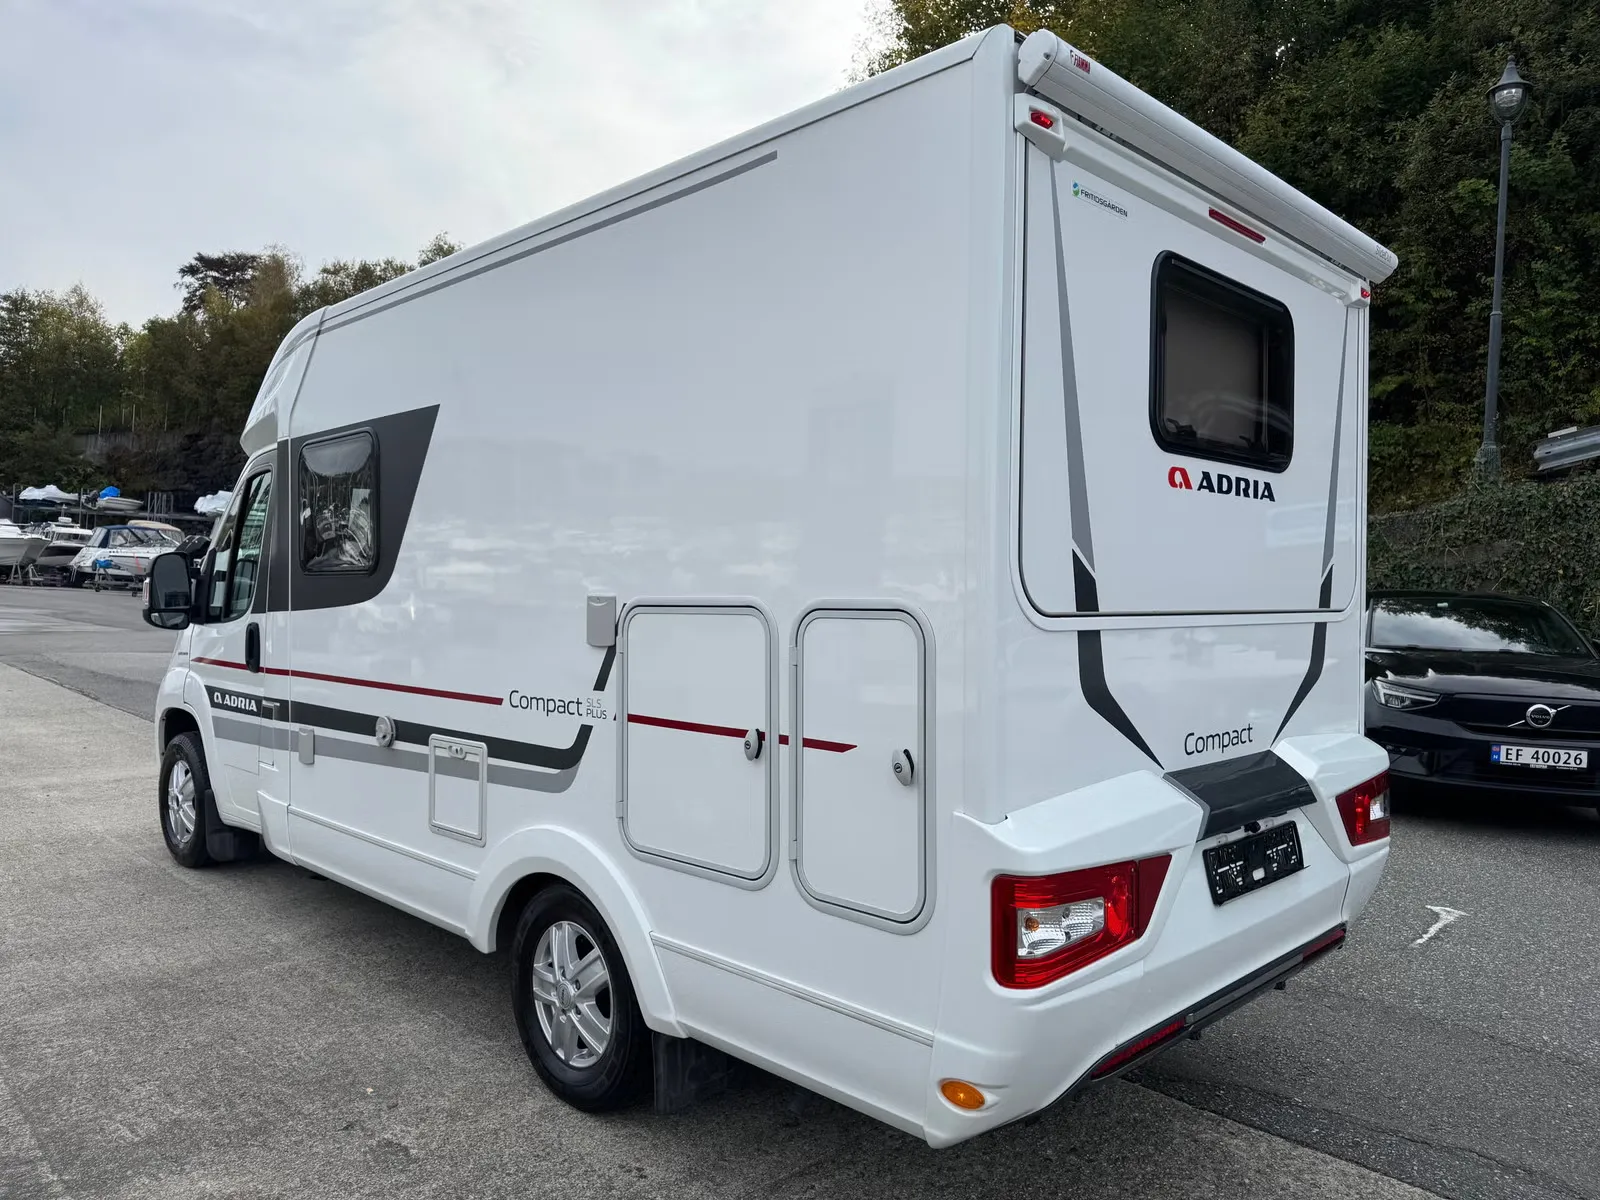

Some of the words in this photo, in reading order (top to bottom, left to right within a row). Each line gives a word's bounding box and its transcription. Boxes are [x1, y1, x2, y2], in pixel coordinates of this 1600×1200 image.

[1080, 189, 1128, 217] FRITIDSGÅRDEN
[1197, 470, 1276, 502] ADRIA
[223, 694, 258, 712] ADRIA
[509, 689, 583, 717] Compact
[586, 697, 602, 709] SLS
[586, 708, 608, 720] PLUS
[1184, 723, 1253, 756] Compact
[1505, 747, 1524, 762] EF
[1530, 749, 1583, 766] 40026
